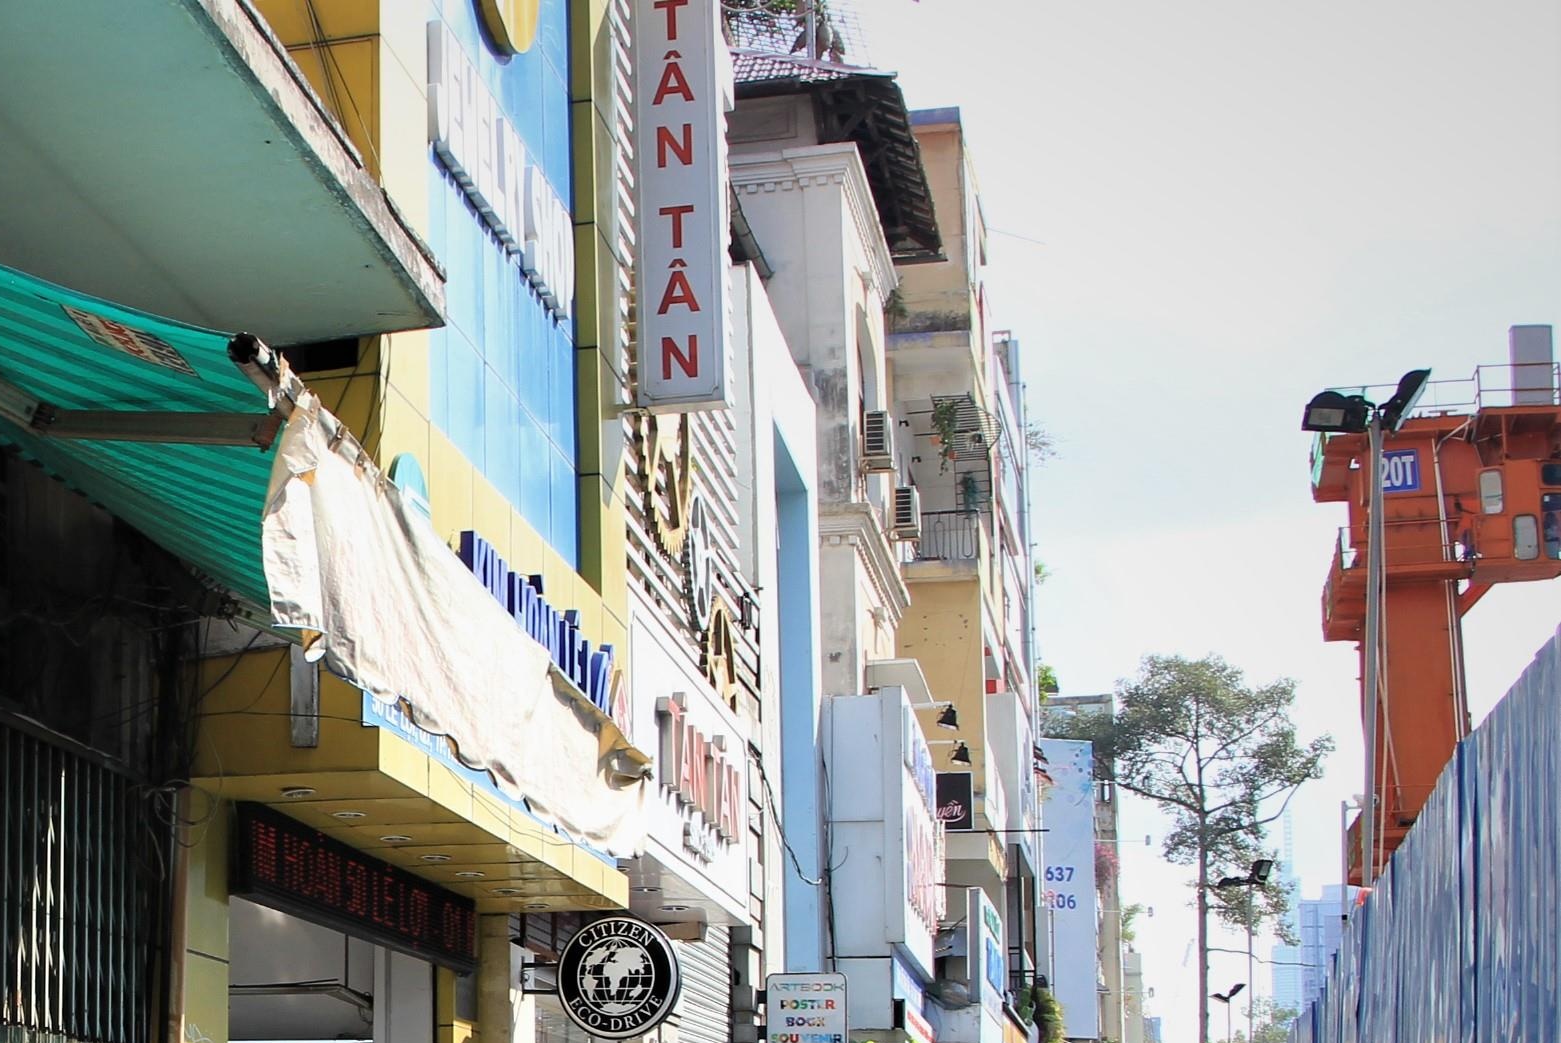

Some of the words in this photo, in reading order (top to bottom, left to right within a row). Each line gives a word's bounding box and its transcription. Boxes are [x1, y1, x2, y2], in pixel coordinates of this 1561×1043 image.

[652, 0, 695, 168] TÂN
[657, 205, 701, 380] TÂN
[1380, 455, 1414, 487] 20T
[1045, 866, 1075, 882] 637
[578, 921, 654, 947] CITIZEN
[769, 983, 845, 992] ARTBOOK
[568, 994, 663, 1031] ECO-DRIVE
[780, 999, 836, 1010] POSTER
[785, 1016, 826, 1027] BOOK
[770, 1033, 843, 1043] SOUVENIR
